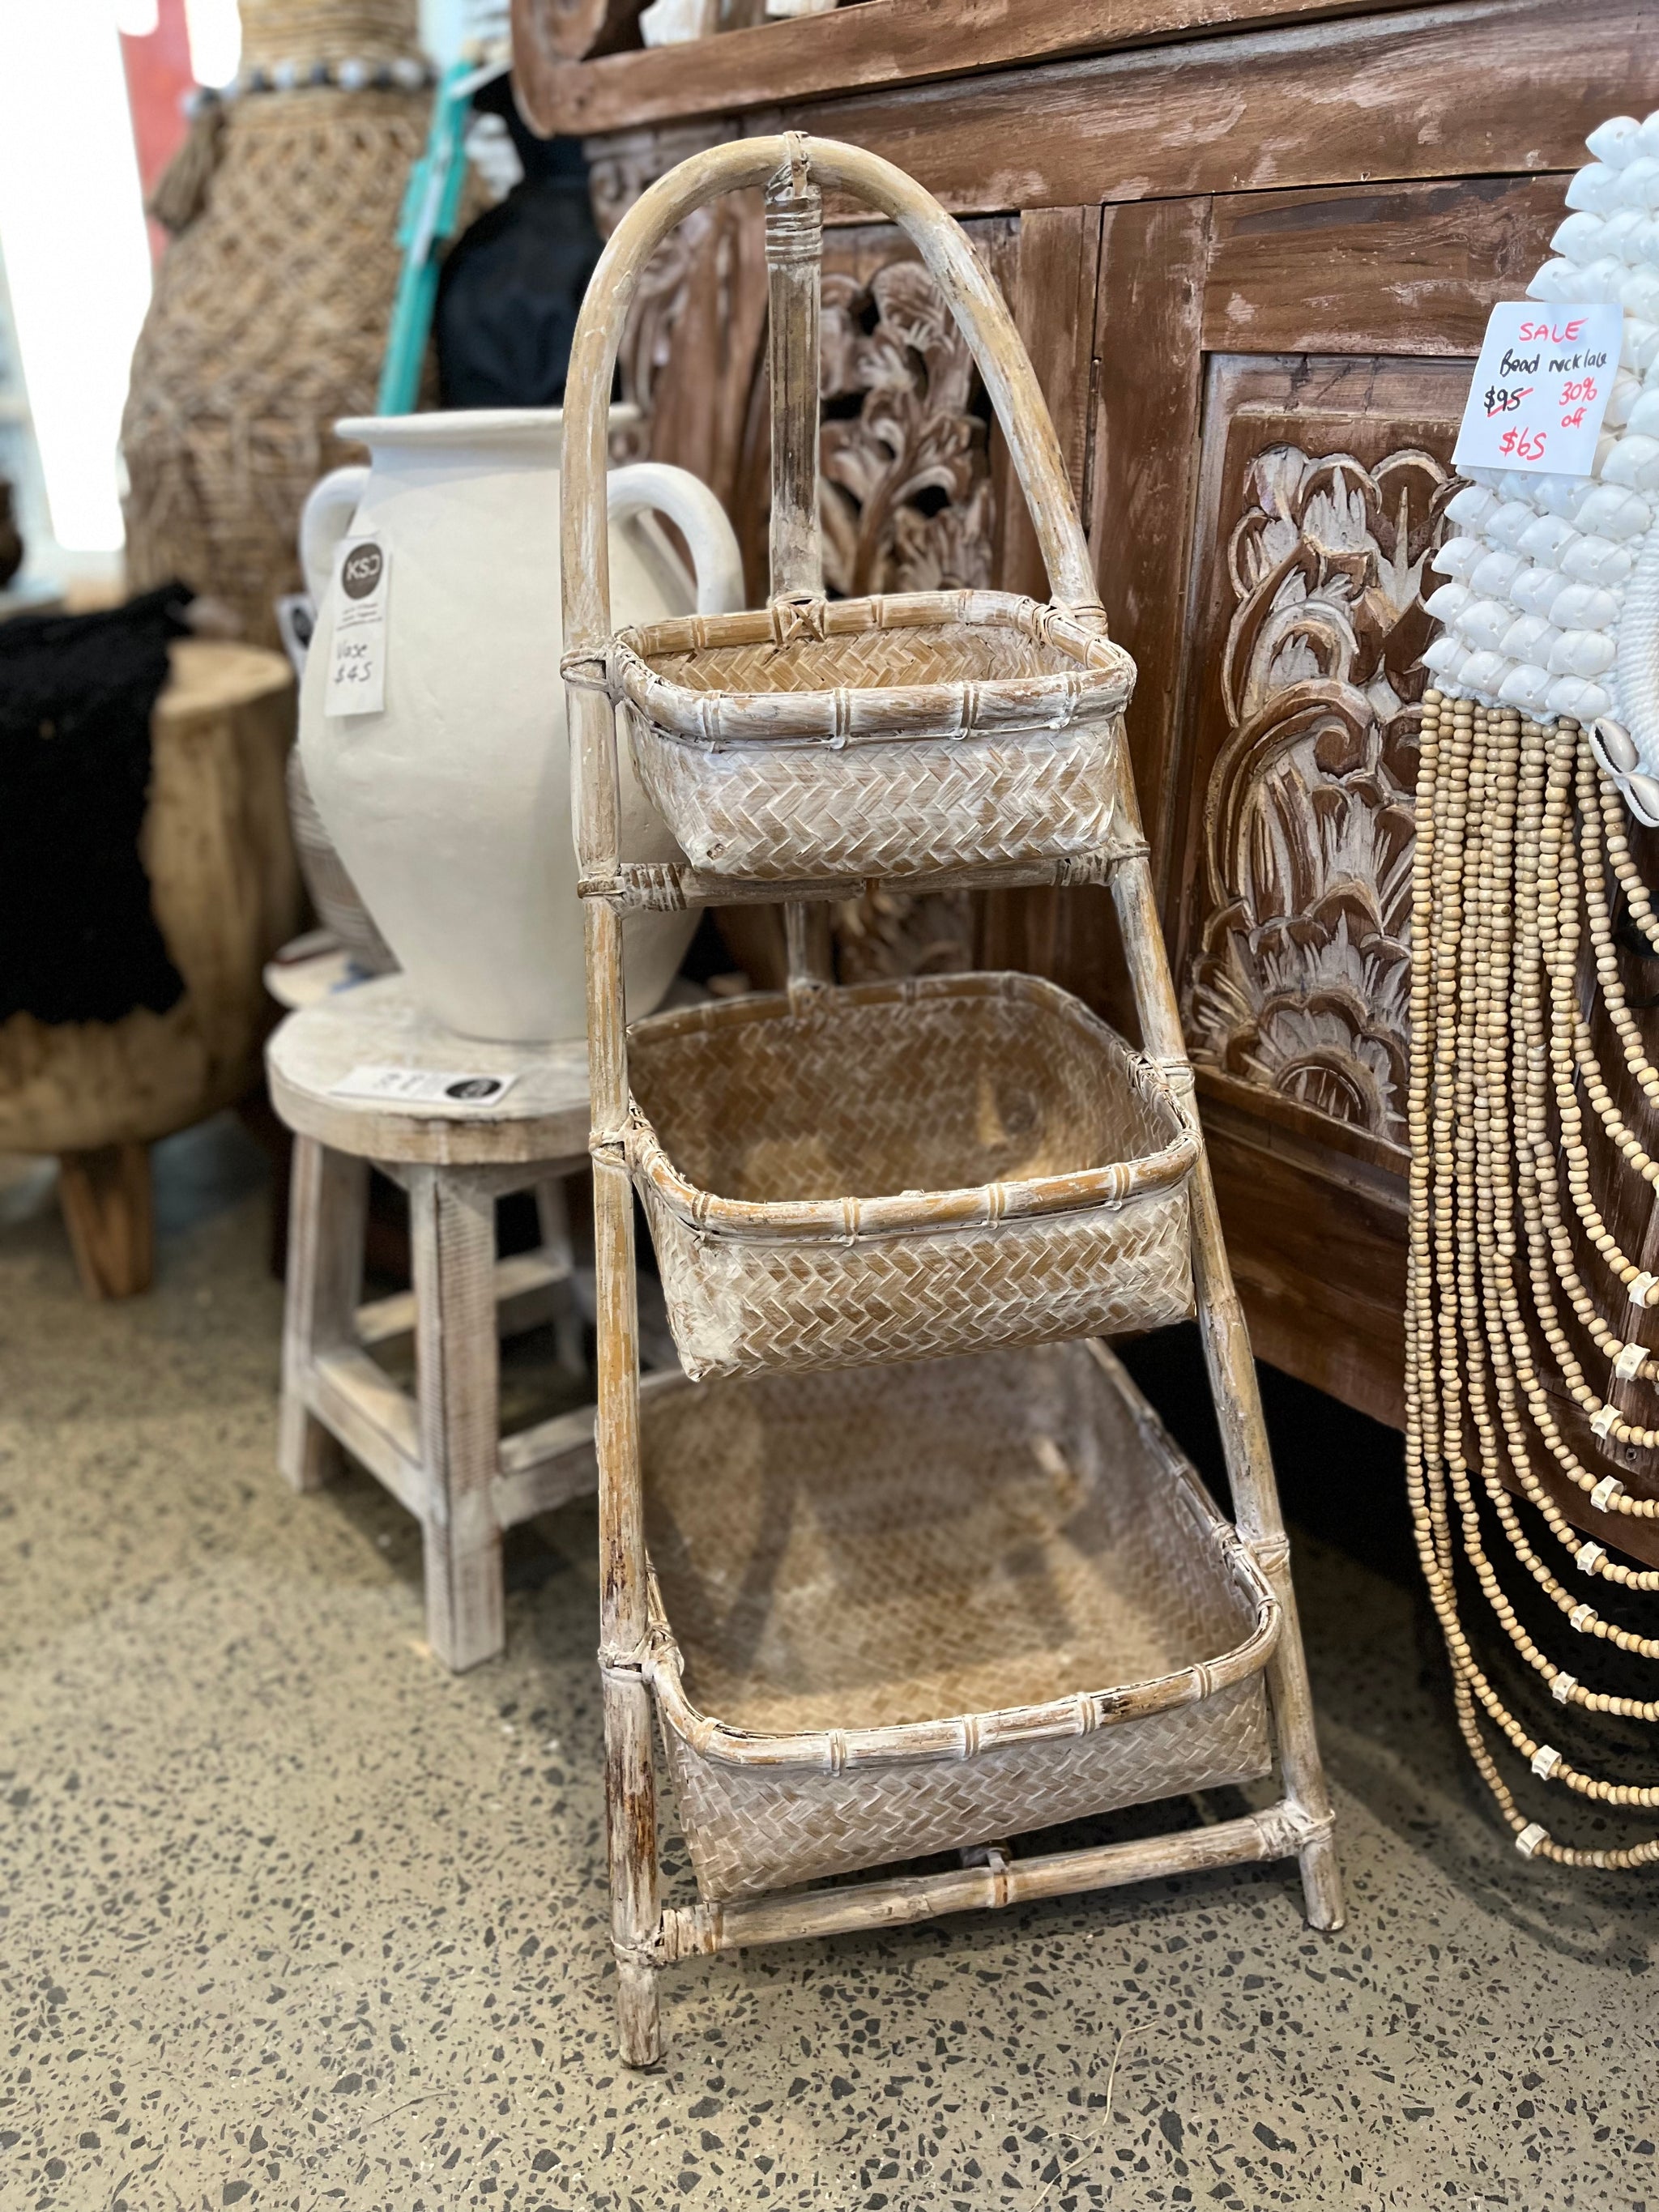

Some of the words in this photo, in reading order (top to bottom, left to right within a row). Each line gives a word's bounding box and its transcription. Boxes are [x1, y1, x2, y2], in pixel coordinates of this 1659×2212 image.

[1519, 318, 1589, 343] SALE
[1499, 348, 1540, 377] Bead
[1484, 386, 1528, 415] $95
[1559, 377, 1597, 406] 30%
[1561, 407, 1587, 428] off
[1499, 427, 1546, 461] $65
